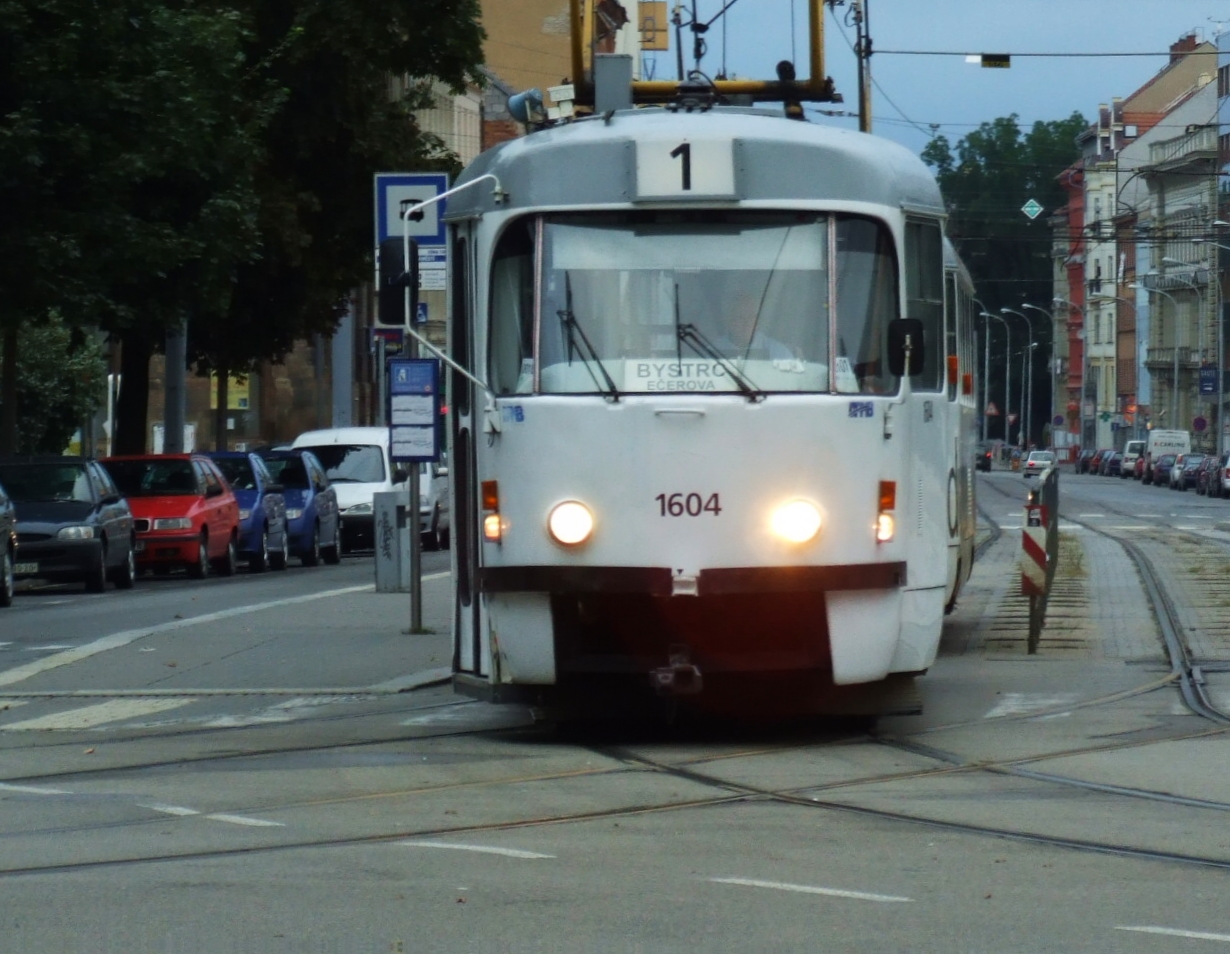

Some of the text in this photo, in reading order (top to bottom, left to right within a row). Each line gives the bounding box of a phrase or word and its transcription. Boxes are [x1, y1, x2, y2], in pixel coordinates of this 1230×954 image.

[670, 143, 691, 191] 1
[647, 379, 716, 391] EČEROVA
[655, 492, 722, 517] 1604
